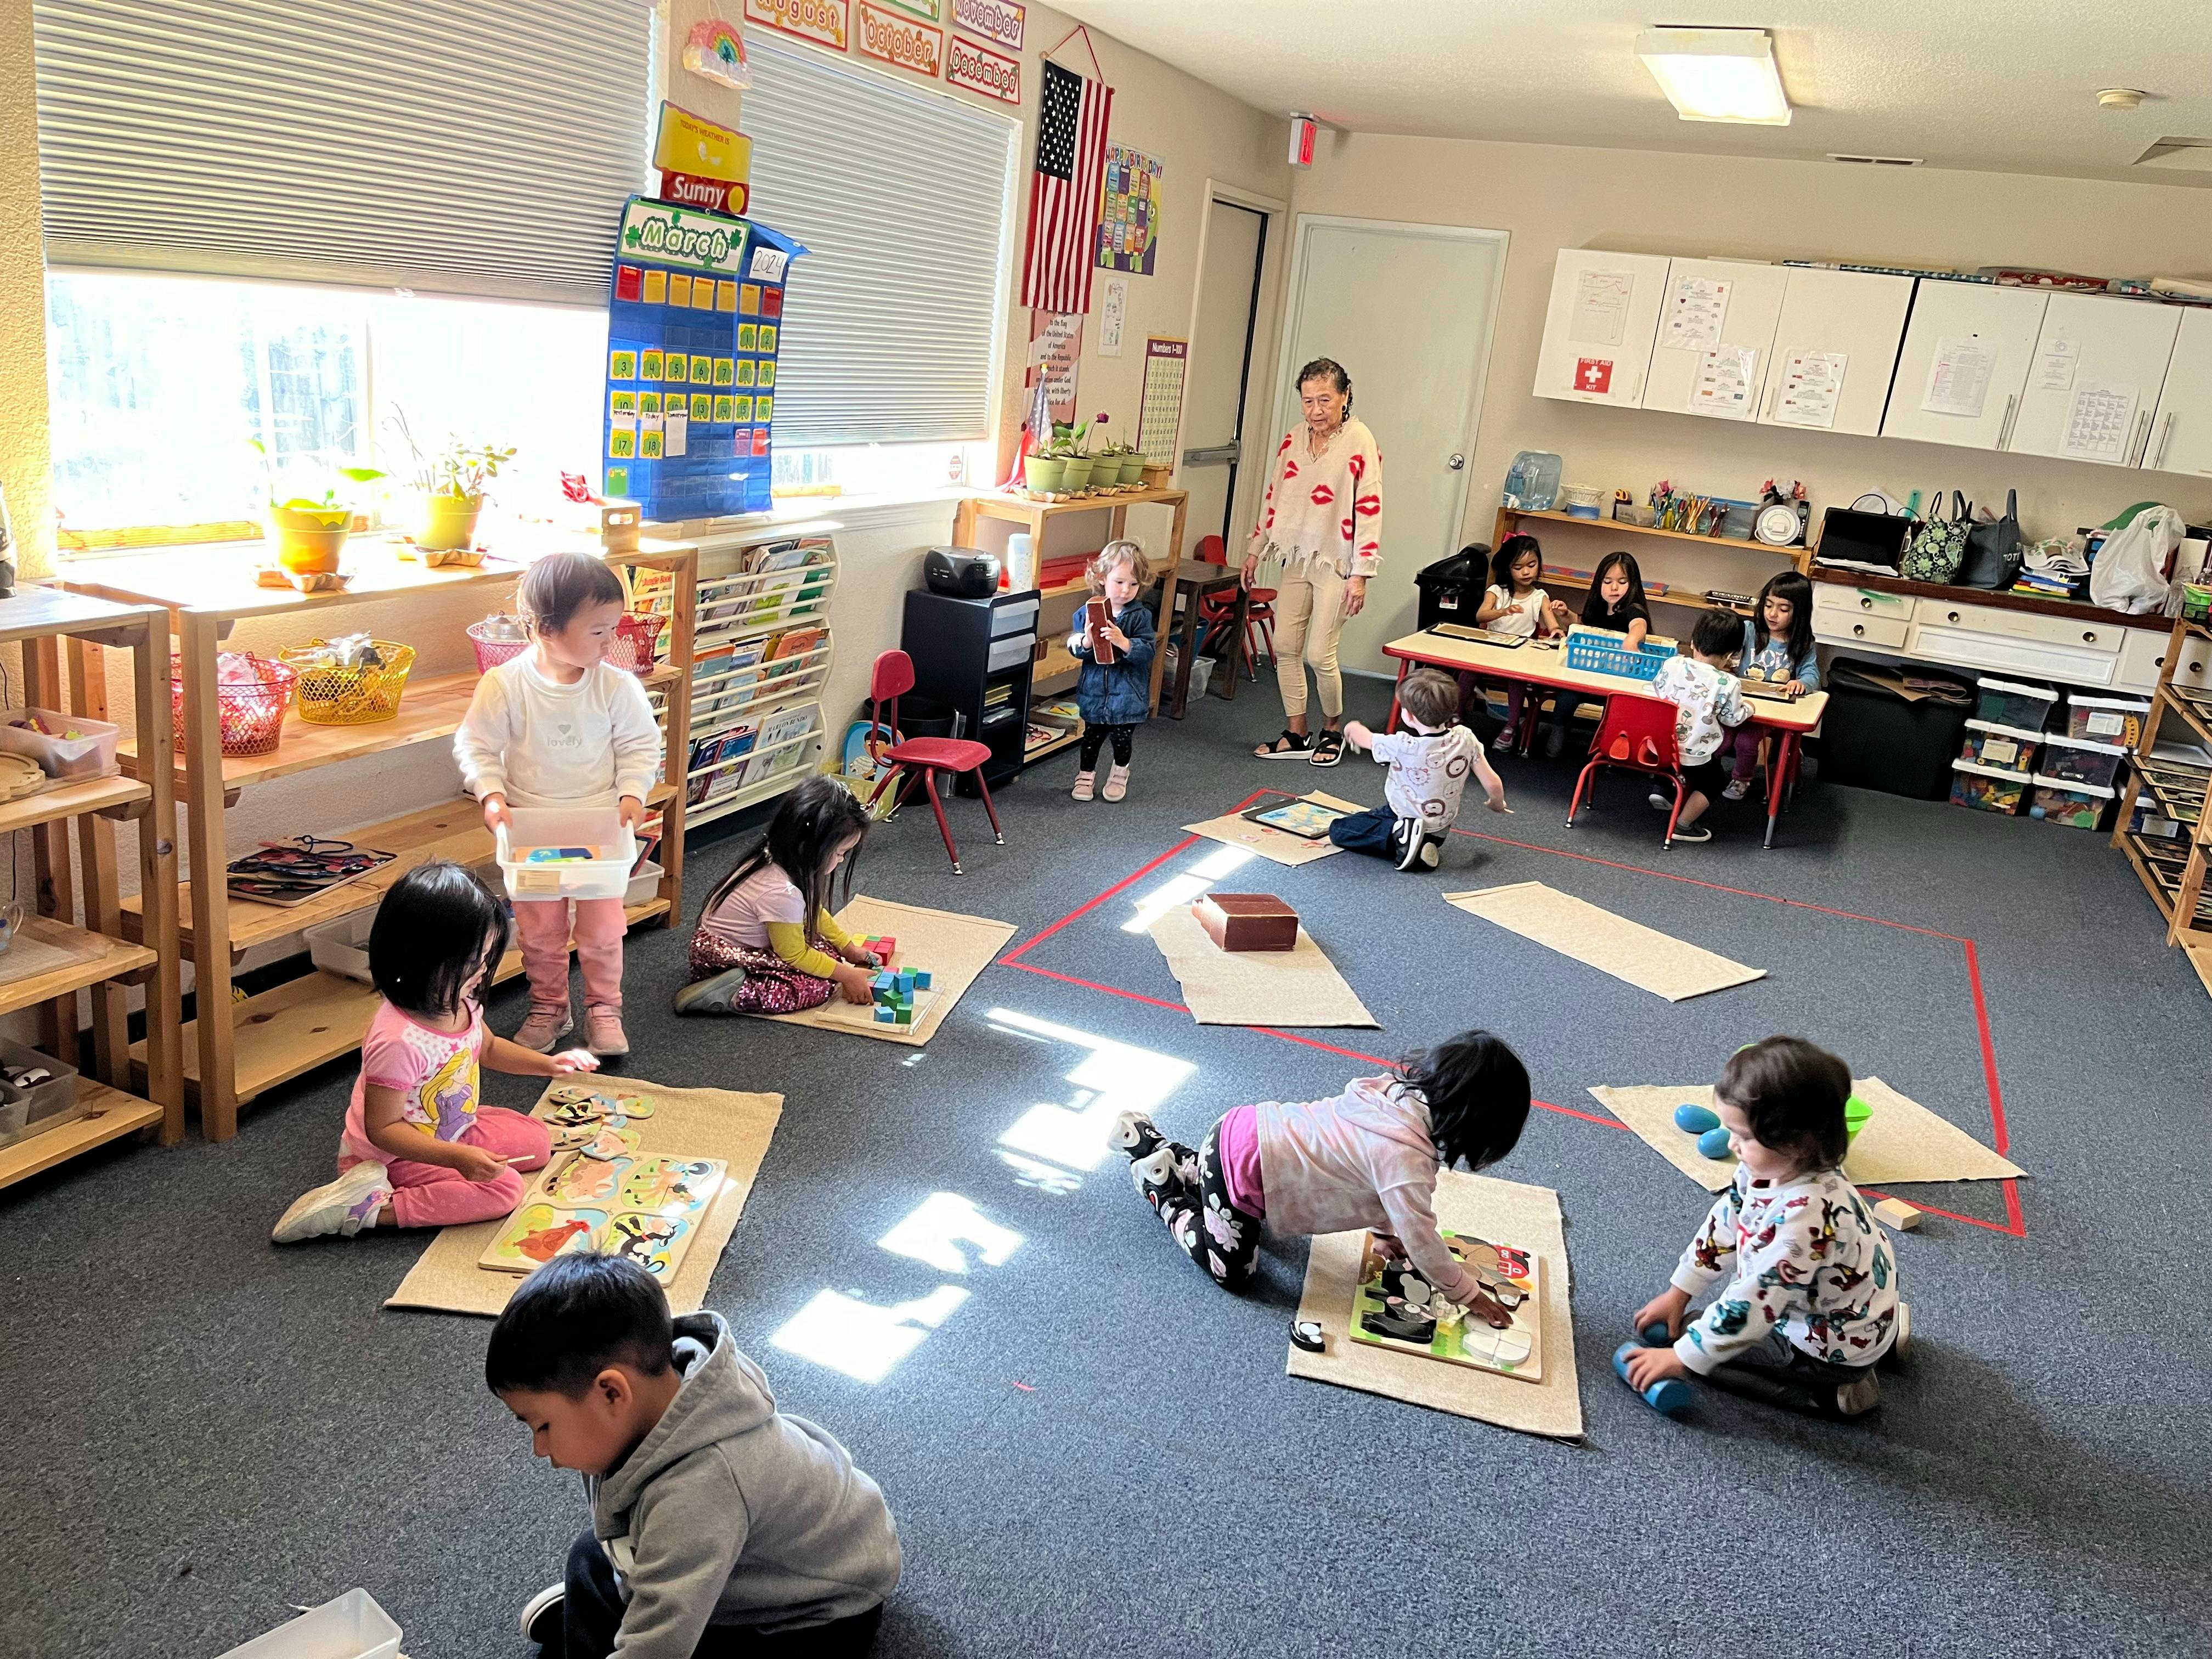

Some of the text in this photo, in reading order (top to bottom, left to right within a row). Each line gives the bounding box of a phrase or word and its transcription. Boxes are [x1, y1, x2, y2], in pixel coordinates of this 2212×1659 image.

[759, 0, 836, 28] ugust
[867, 20, 931, 61] October
[953, 52, 1015, 91] December
[680, 120, 698, 133] TODAY'S
[699, 128, 724, 144] WEATHER
[1106, 146, 1128, 165] HAPPY
[673, 175, 725, 210] Sunny
[643, 221, 726, 257] March
[753, 251, 785, 276] 2024
[765, 335, 769, 345] 2
[1152, 342, 1171, 354] Numbers
[621, 362, 627, 371] 3
[650, 363, 654, 373] 4
[674, 364, 679, 373] 5
[699, 366, 703, 375] 6
[723, 368, 727, 377] 7
[744, 370, 748, 379] 8
[646, 413, 659, 421] Today
[698, 404, 704, 414] 13
[720, 405, 727, 414] 14
[741, 405, 747, 414] 15
[761, 405, 767, 415] 16
[619, 440, 656, 451] 17 18
[547, 736, 582, 748] lovely
